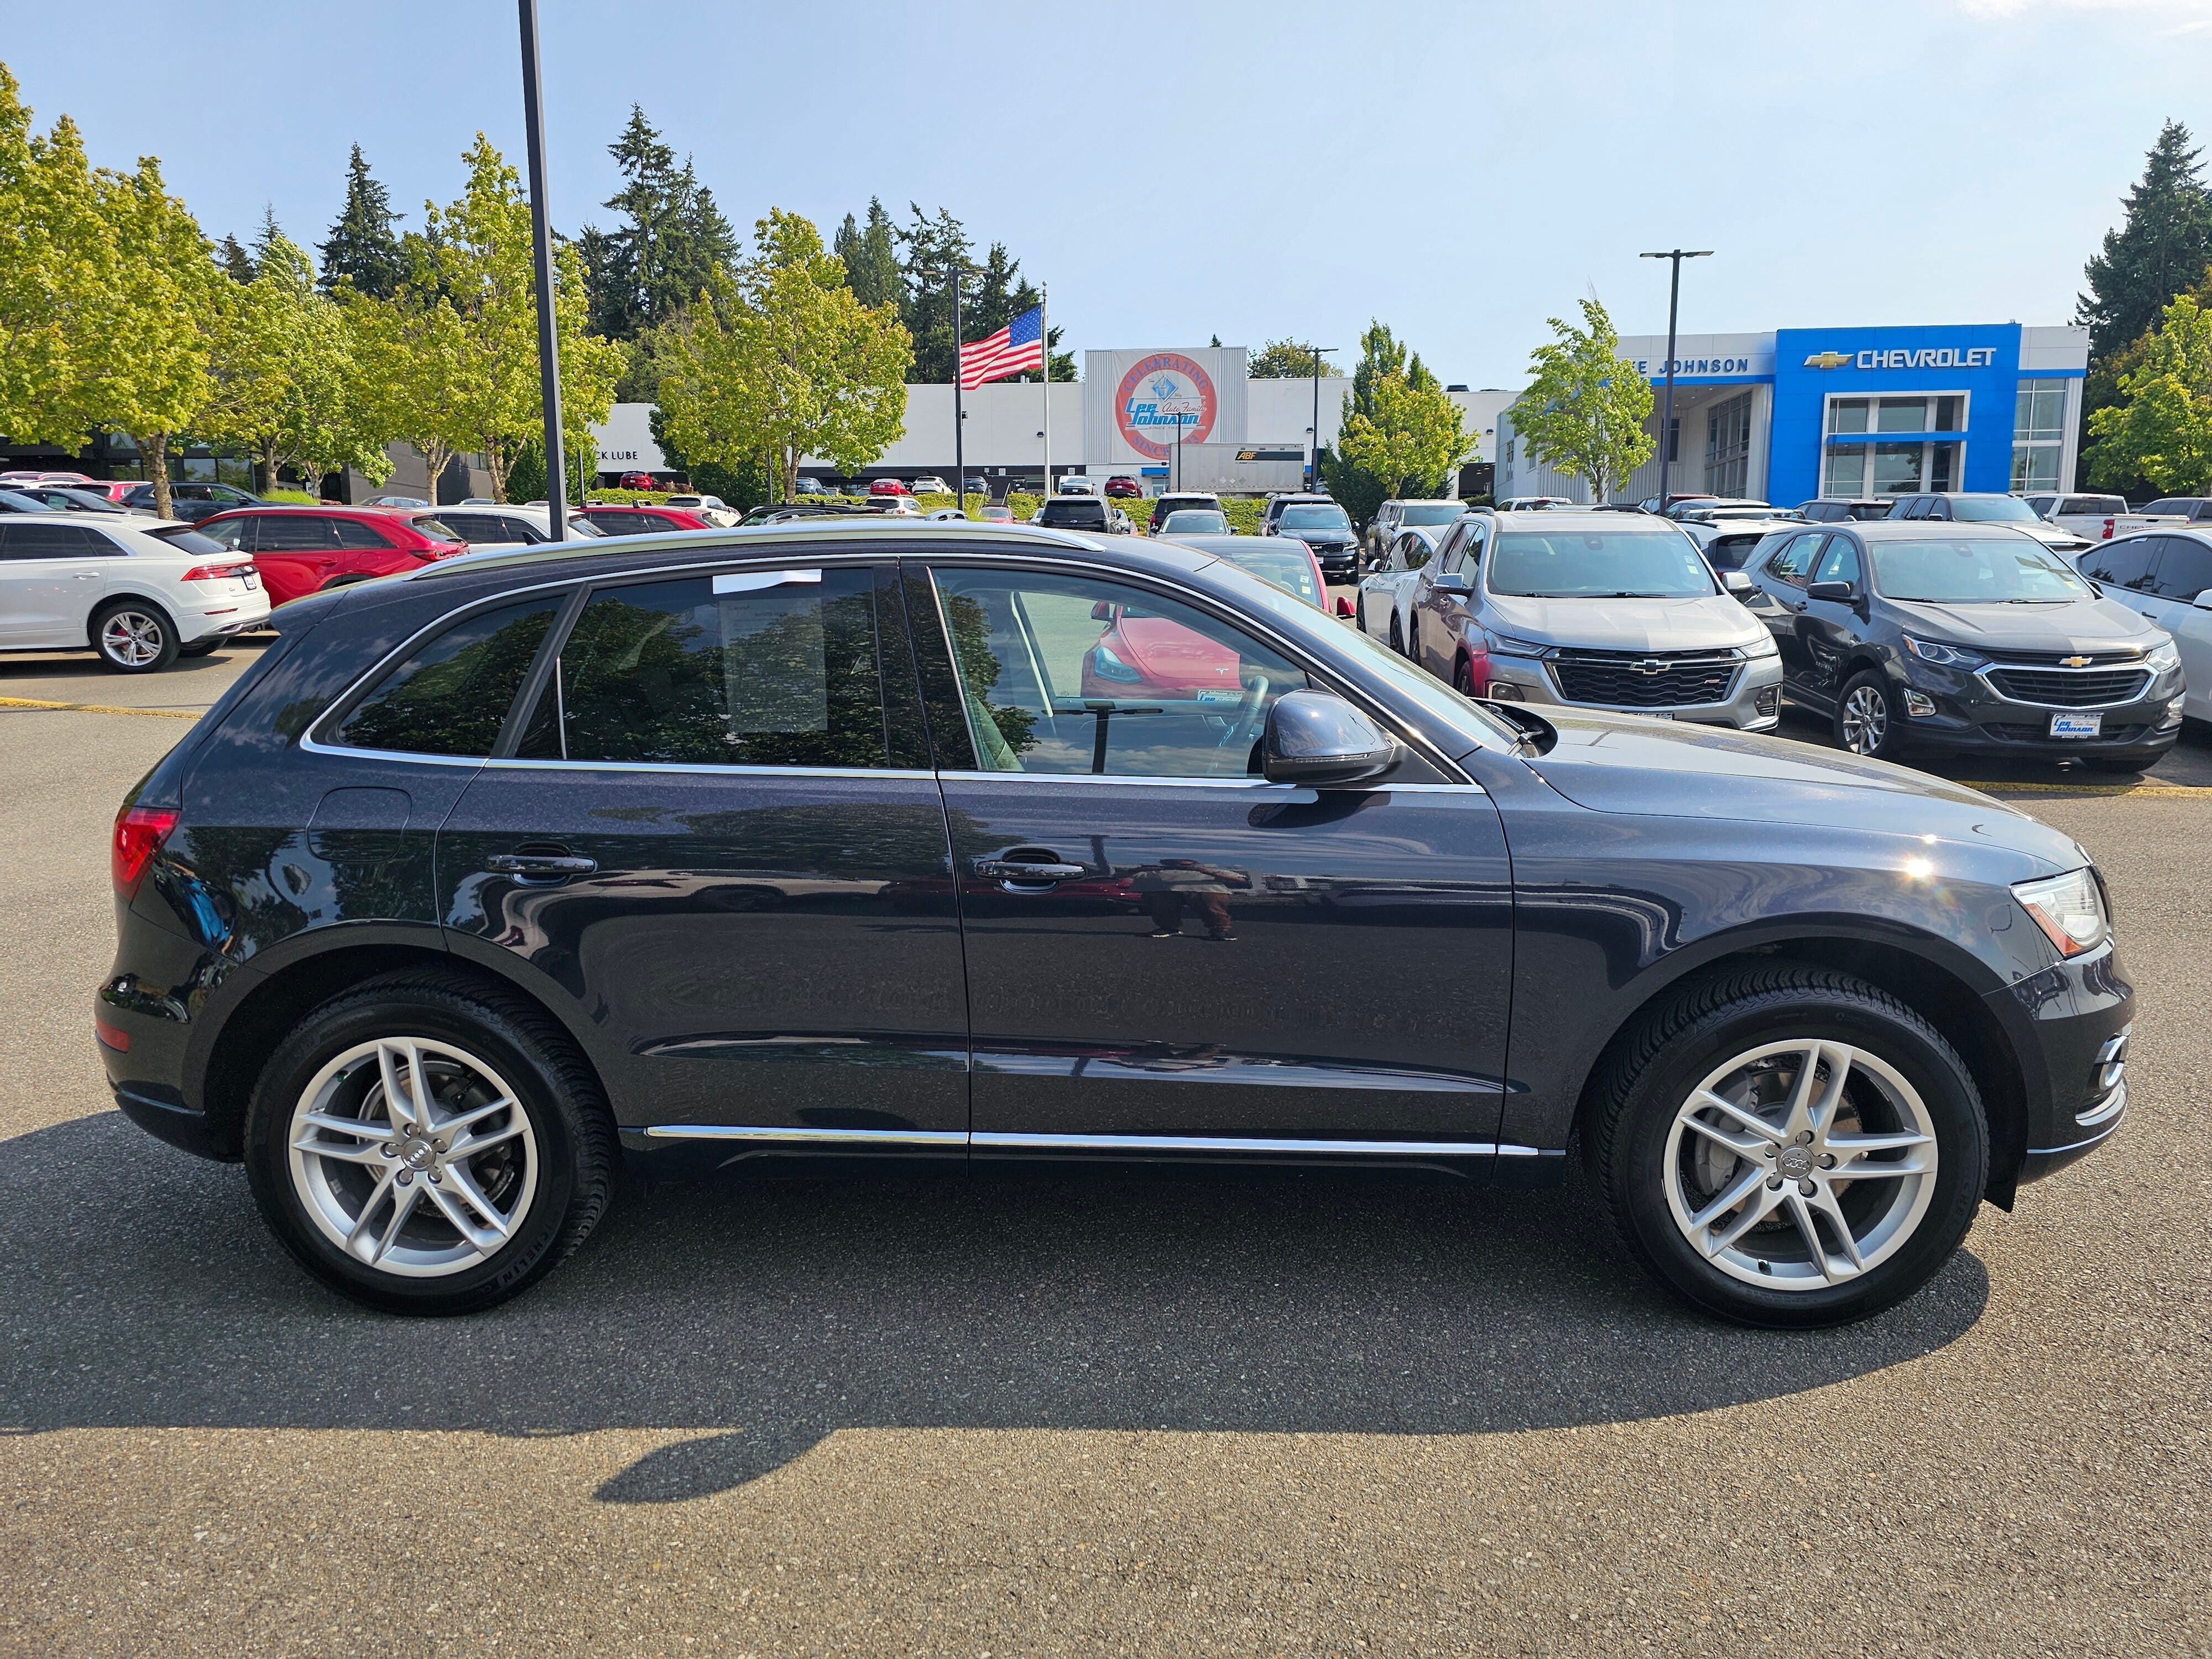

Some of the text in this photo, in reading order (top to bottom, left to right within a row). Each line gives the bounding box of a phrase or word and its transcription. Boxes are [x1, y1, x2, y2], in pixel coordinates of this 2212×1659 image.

[1857, 348, 1996, 368] CHEVROLET
[1659, 359, 1748, 373] JOHNSON
[1124, 357, 1208, 392] CELEBRATING
[1126, 398, 1159, 413] Lee
[1162, 401, 1207, 416] Auto Family
[1128, 410, 1201, 425] Johnson
[612, 451, 638, 460] LUBE
